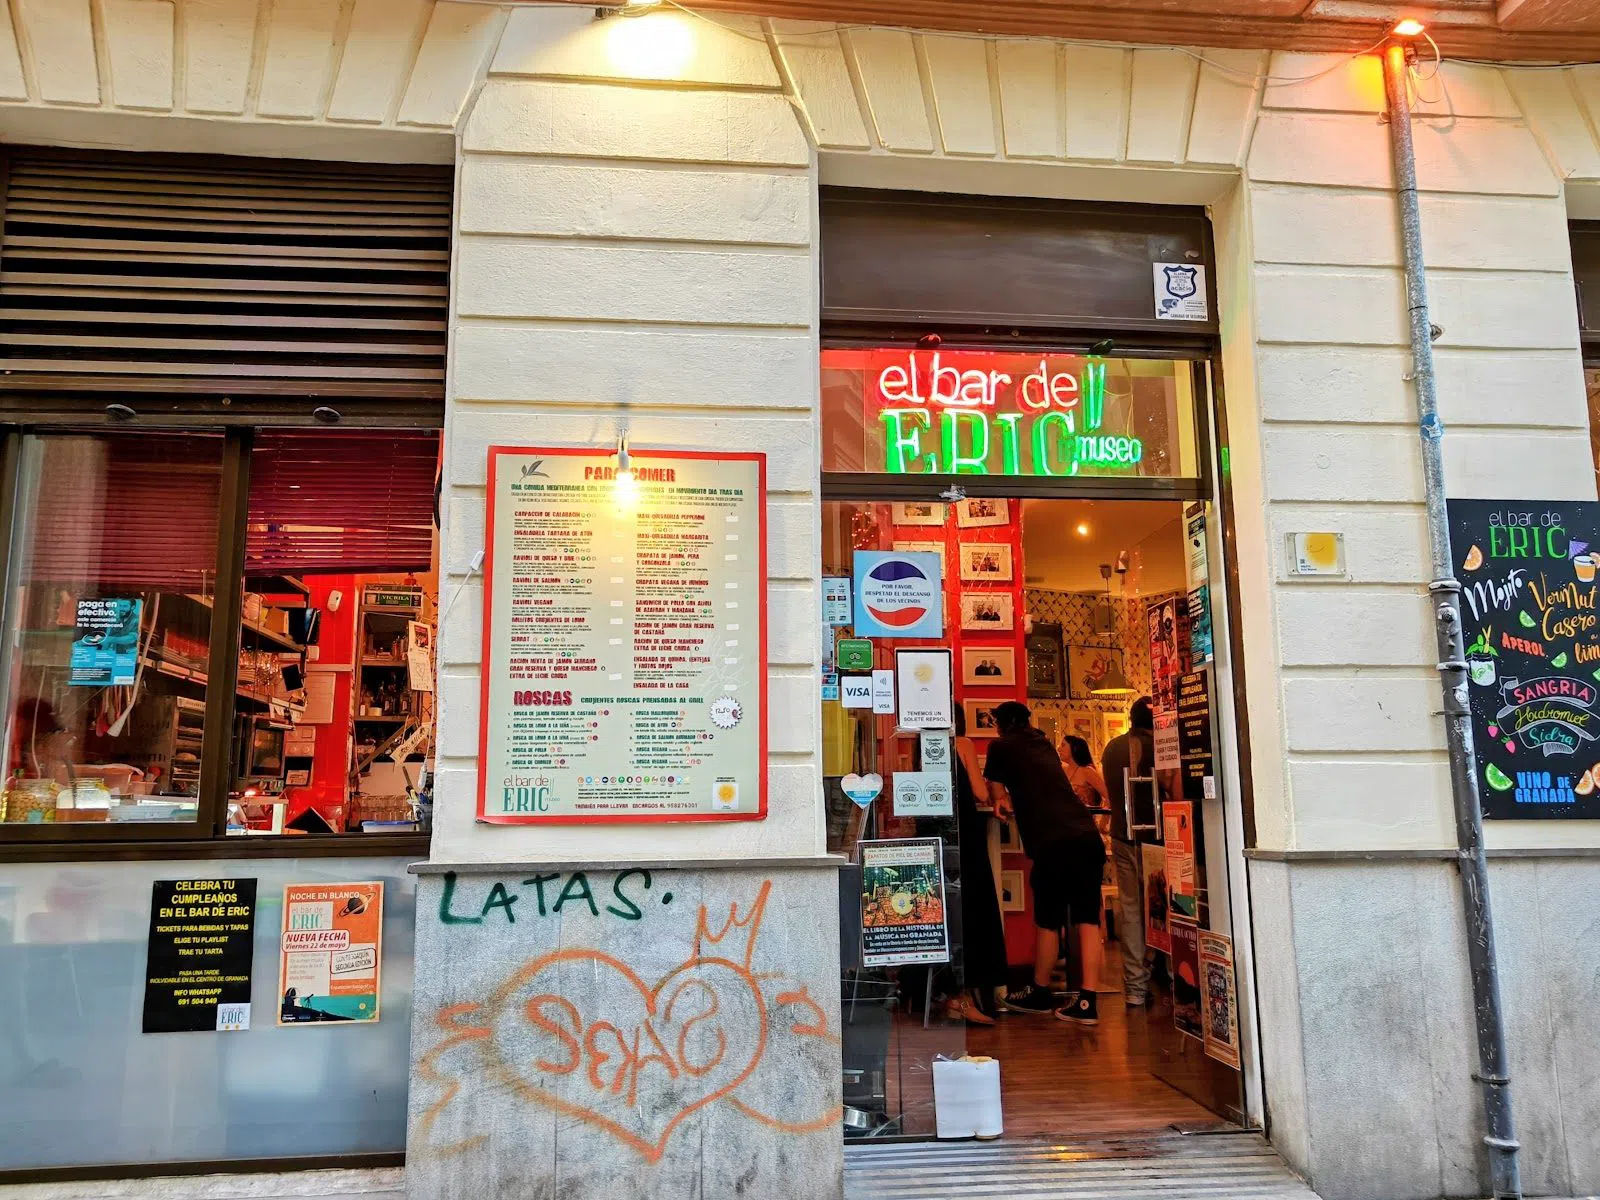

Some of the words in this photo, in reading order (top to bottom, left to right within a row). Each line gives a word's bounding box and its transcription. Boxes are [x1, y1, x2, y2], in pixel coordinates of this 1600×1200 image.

[879, 353, 925, 404] el
[931, 352, 1012, 405] bar
[1020, 359, 1079, 409] de
[1075, 434, 1142, 464] museo
[1489, 510, 1504, 527] el
[1507, 510, 1534, 527] bar
[1540, 510, 1562, 527] de
[1489, 526, 1568, 559] ERIC
[1464, 568, 1528, 621] Mojito
[78, 600, 104, 608] paga
[1542, 606, 1596, 641] Casero
[1502, 631, 1546, 657] APEROL
[513, 691, 572, 706] ROSCAS
[845, 688, 870, 696] VISA
[1513, 680, 1589, 704] SANGRIA
[1529, 727, 1575, 746] Sidra
[503, 775, 513, 787] el
[515, 775, 532, 787] bar
[535, 775, 549, 787] de
[1557, 776, 1571, 789] DE
[502, 787, 550, 812] ERIC
[1515, 788, 1576, 803] GRANADA
[175, 881, 220, 891] CELEBRA
[222, 880, 235, 890] TU
[171, 892, 237, 904] CUMPLEAÑOS
[330, 891, 360, 899] BLANCO
[160, 908, 173, 918] EN
[175, 908, 187, 917] EL
[189, 908, 210, 917] BAR
[212, 907, 225, 917] DE
[227, 906, 250, 916] ERIC
[292, 913, 323, 929] ERIC
[286, 933, 317, 942] NUEVA
[319, 932, 347, 941] FECHA
[221, 1011, 243, 1023] ERIC
